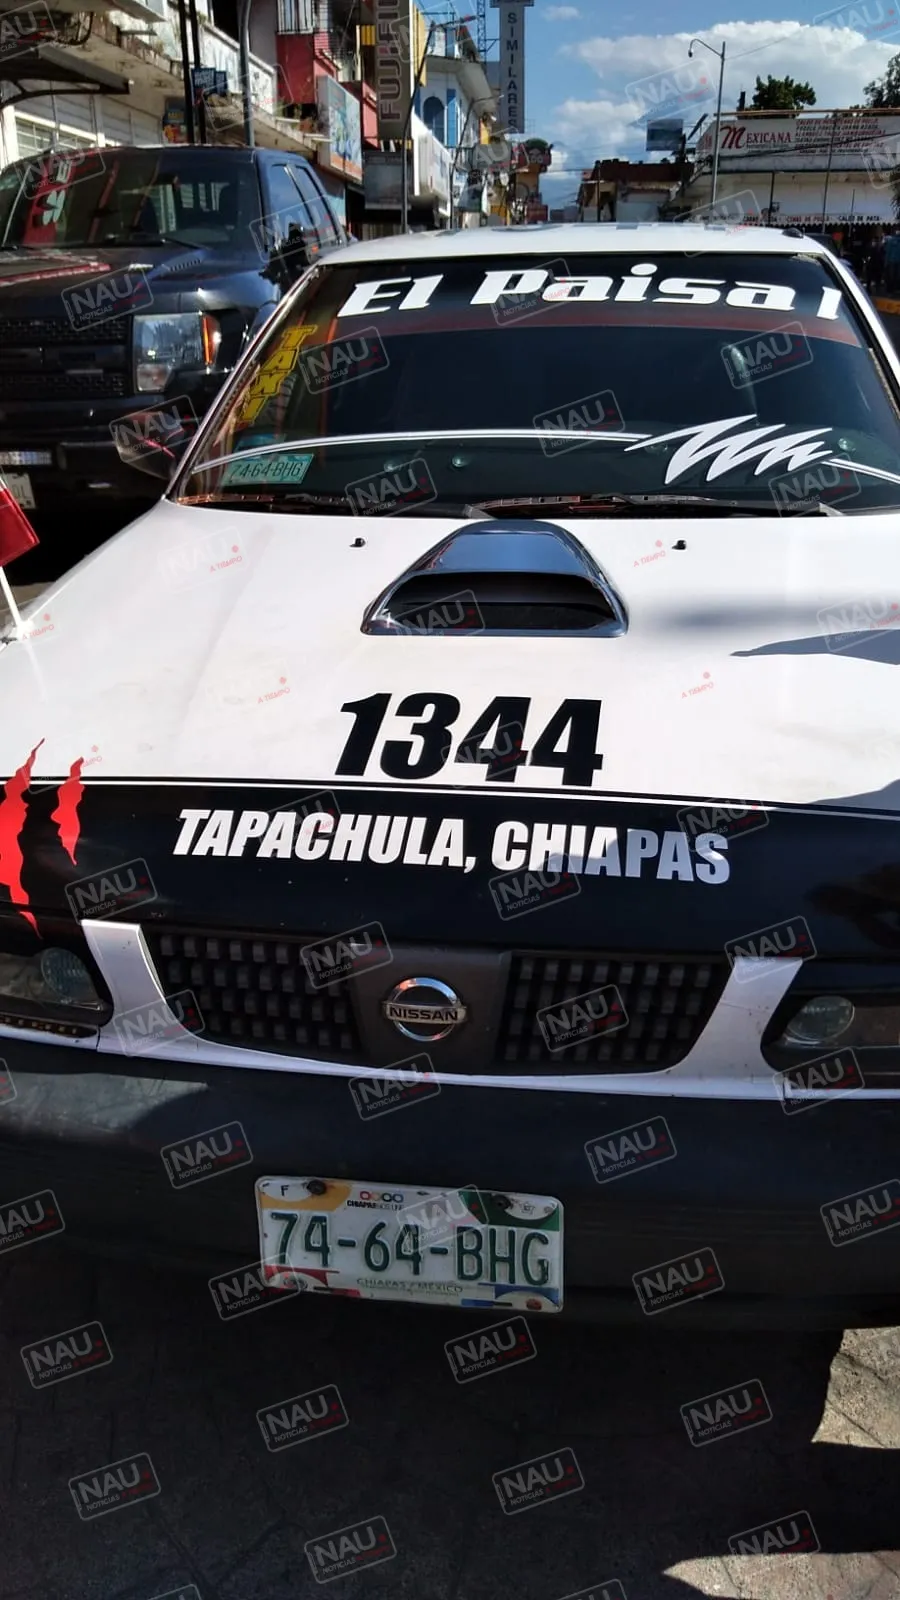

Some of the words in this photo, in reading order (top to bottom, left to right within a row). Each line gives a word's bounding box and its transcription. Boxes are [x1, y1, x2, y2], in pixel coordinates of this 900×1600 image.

[506, 12, 518, 133] SIMILARES
[337, 274, 444, 317] El
[470, 263, 795, 310] Paisa
[238, 324, 318, 424] TAXI
[335, 692, 603, 787] 1344
[173, 809, 476, 873] TAPACHULA,
[492, 821, 729, 884] CHIAPAS
[389, 1006, 458, 1021] NISSAN
[270, 1212, 550, 1286] 74-64-BHG
